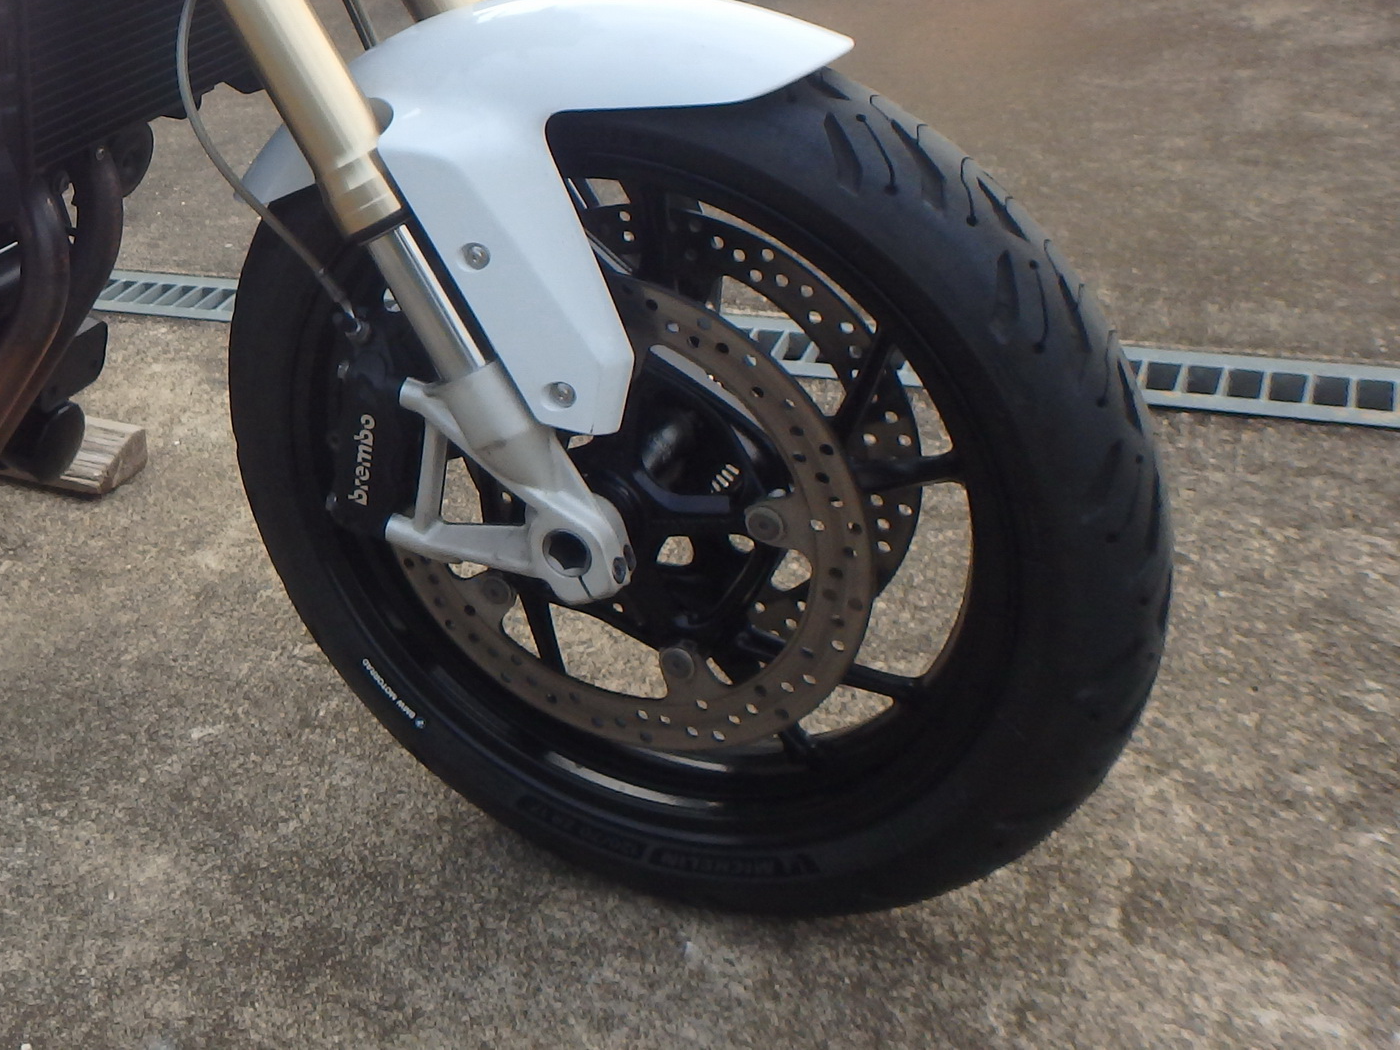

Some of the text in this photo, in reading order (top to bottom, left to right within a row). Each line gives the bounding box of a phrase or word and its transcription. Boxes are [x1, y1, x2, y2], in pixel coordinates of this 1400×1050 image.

[348, 414, 376, 506] brembo
[362, 658, 417, 719] BMW MOTORRAD
[658, 852, 774, 876] MICHELIN
